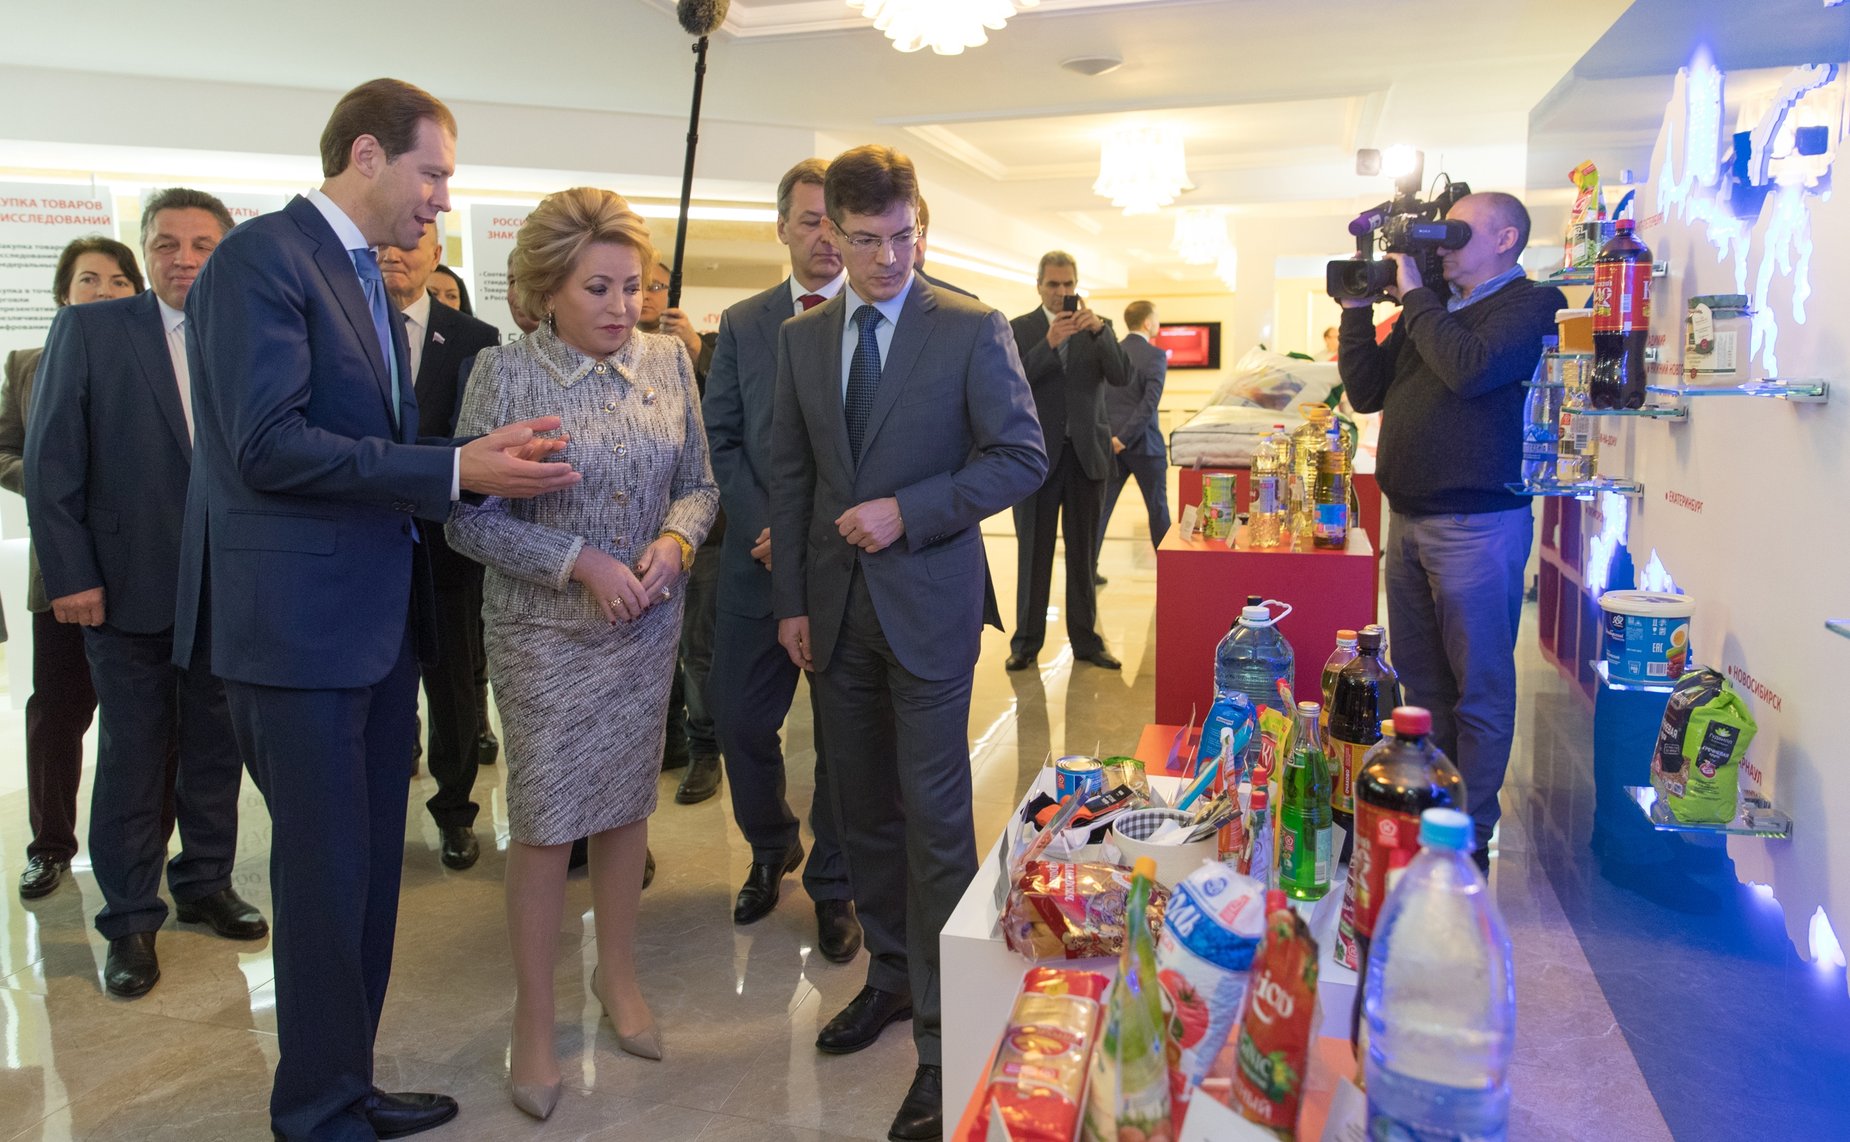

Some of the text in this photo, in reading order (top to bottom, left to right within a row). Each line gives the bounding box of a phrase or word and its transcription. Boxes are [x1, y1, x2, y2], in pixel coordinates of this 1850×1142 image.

[42, 199, 103, 211] ТОВАРОВ
[0, 213, 111, 225] ИССЛЕДОВАНИЙ
[487, 230, 514, 240] ЗНАК
[1668, 490, 1704, 514] ЕКАТЕРИНБУРГ
[1733, 665, 1782, 713] НОВОСИБИРСК
